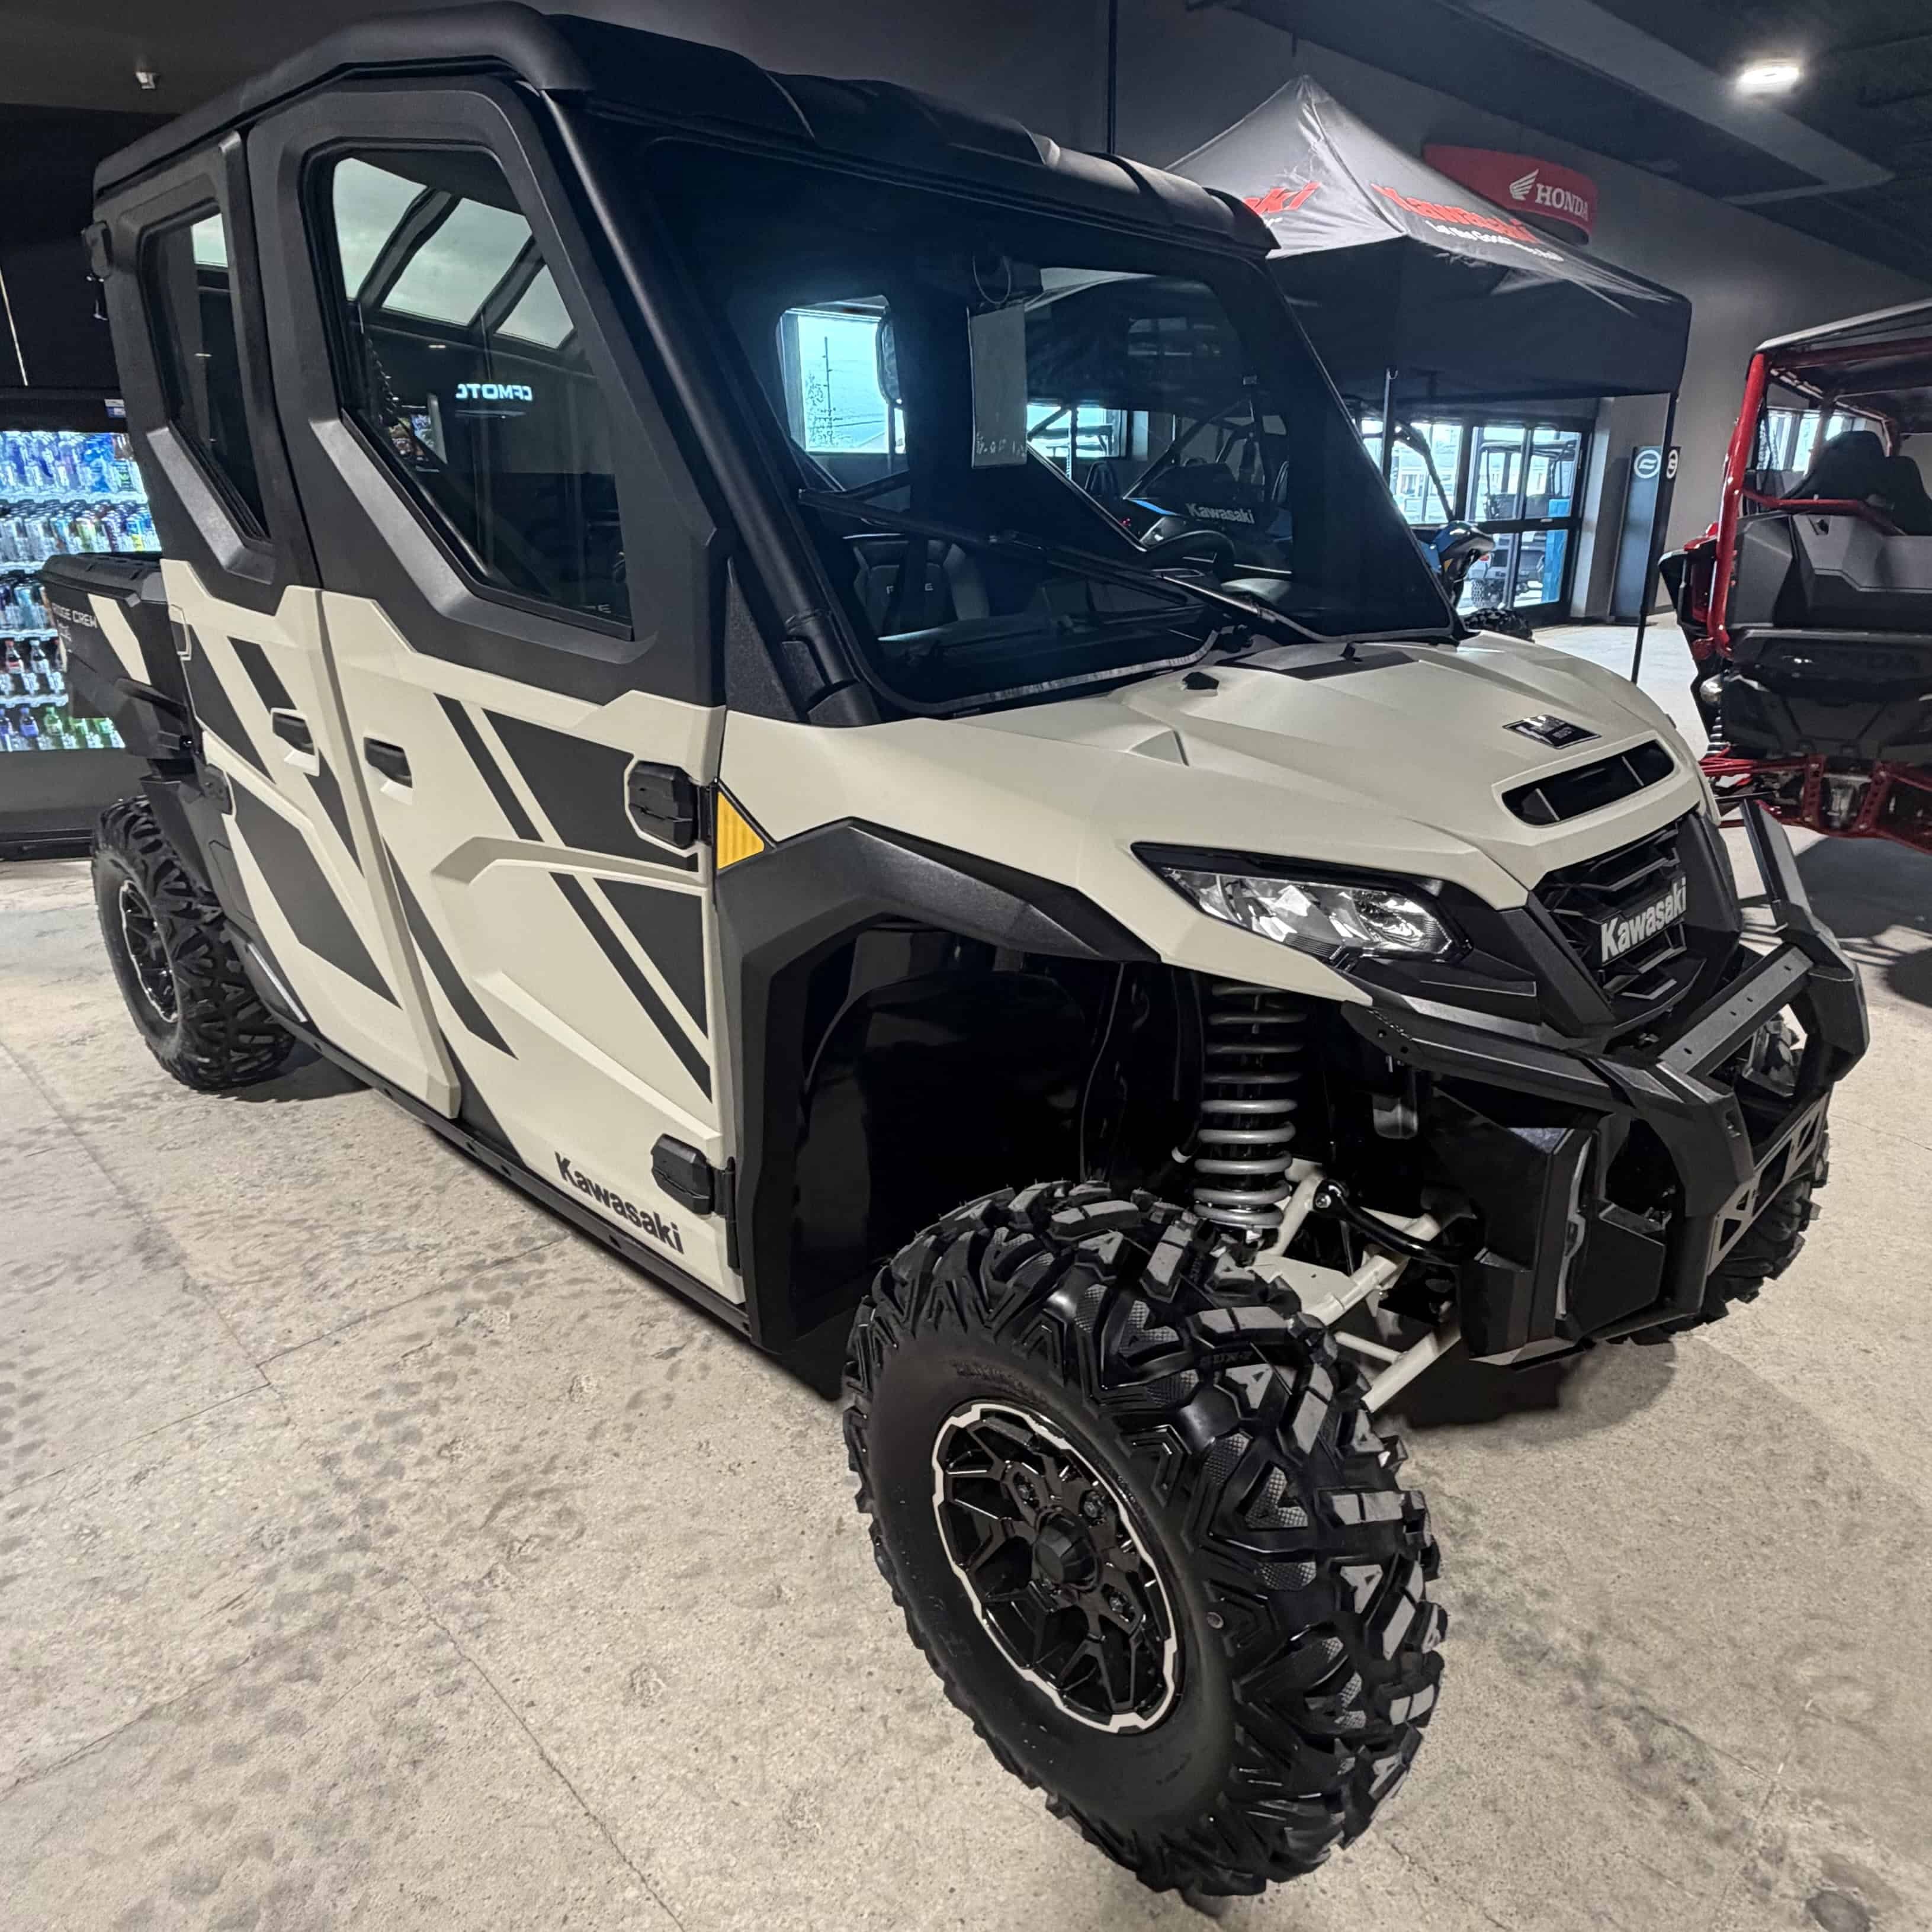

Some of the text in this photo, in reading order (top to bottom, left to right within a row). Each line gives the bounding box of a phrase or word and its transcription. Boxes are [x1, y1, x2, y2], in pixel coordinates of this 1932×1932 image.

[1535, 183, 1588, 221] HONDA
[1185, 503, 1255, 525] Kawasaki
[1601, 877, 1686, 961] Kawasaki
[554, 1151, 685, 1255] Kawasaki
